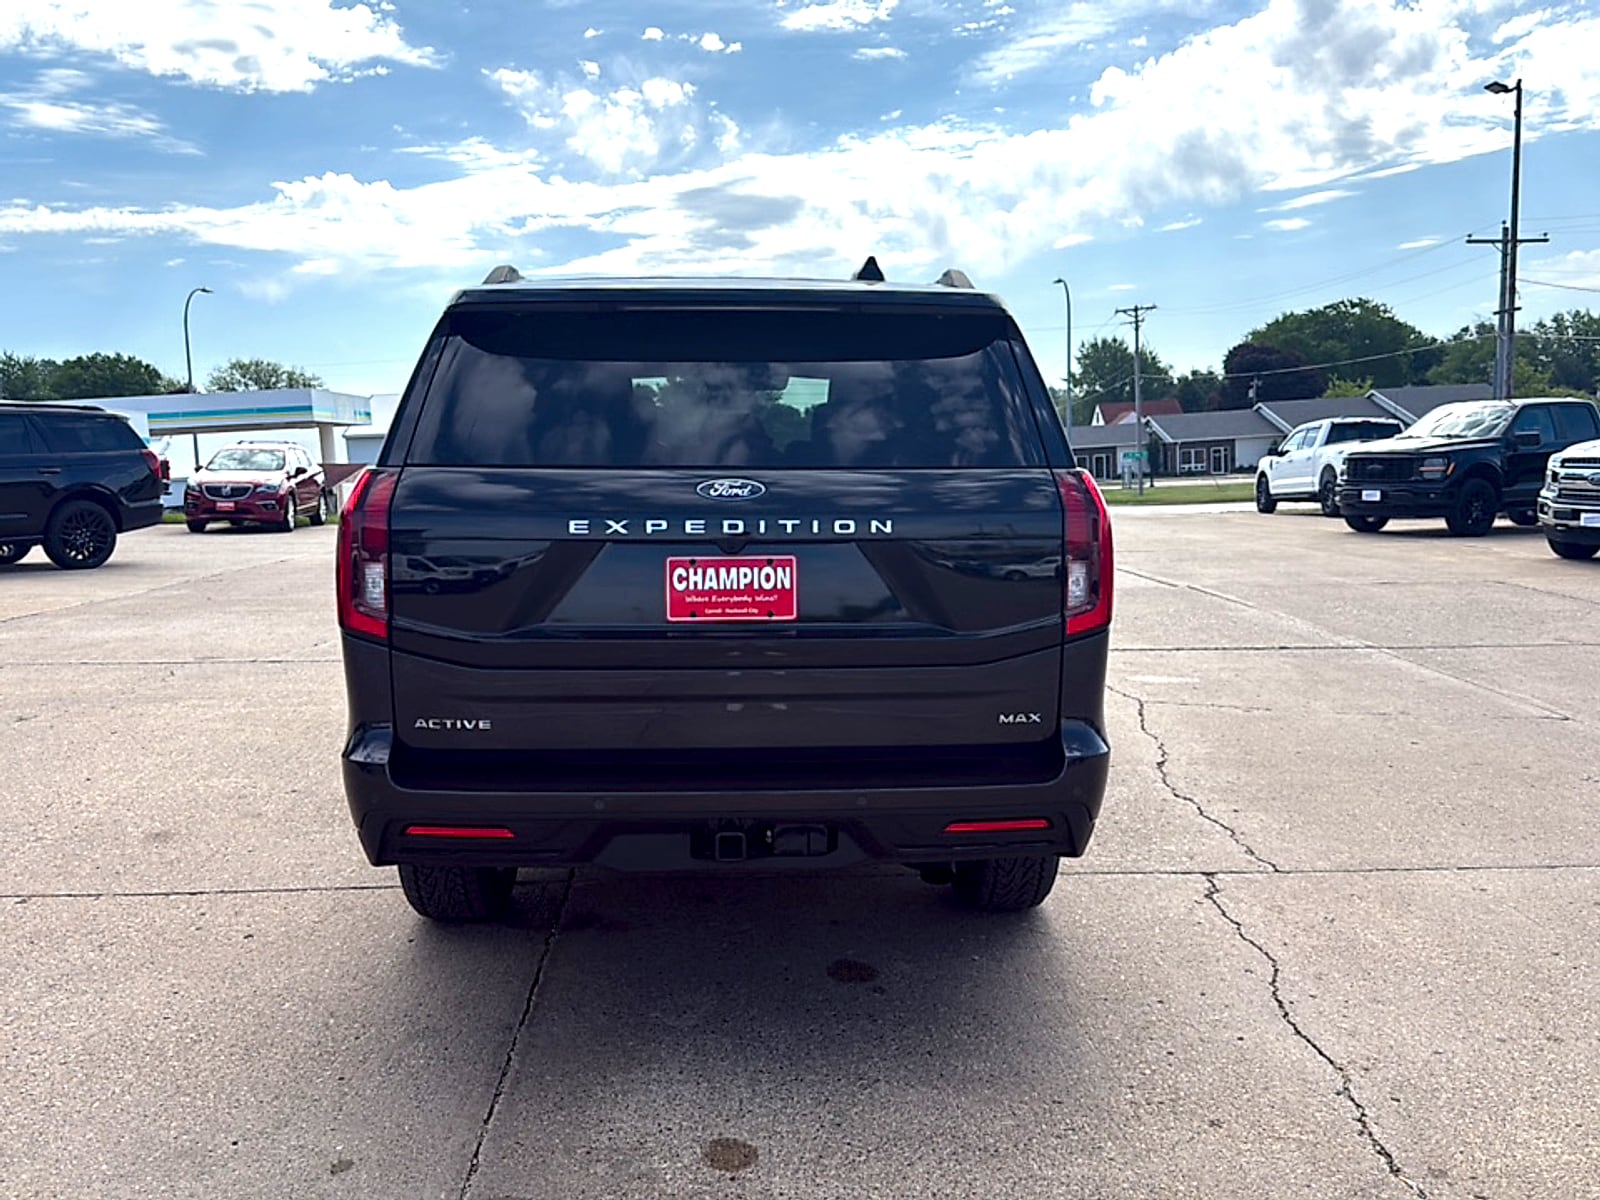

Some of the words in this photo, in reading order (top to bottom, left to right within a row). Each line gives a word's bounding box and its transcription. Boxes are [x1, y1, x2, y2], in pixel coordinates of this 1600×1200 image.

[708, 480, 753, 497] Ford
[568, 519, 893, 535] EXPEDITION
[672, 566, 792, 591] CHAMPION
[414, 718, 492, 730] ACTIVE
[999, 713, 1042, 724] MAX
